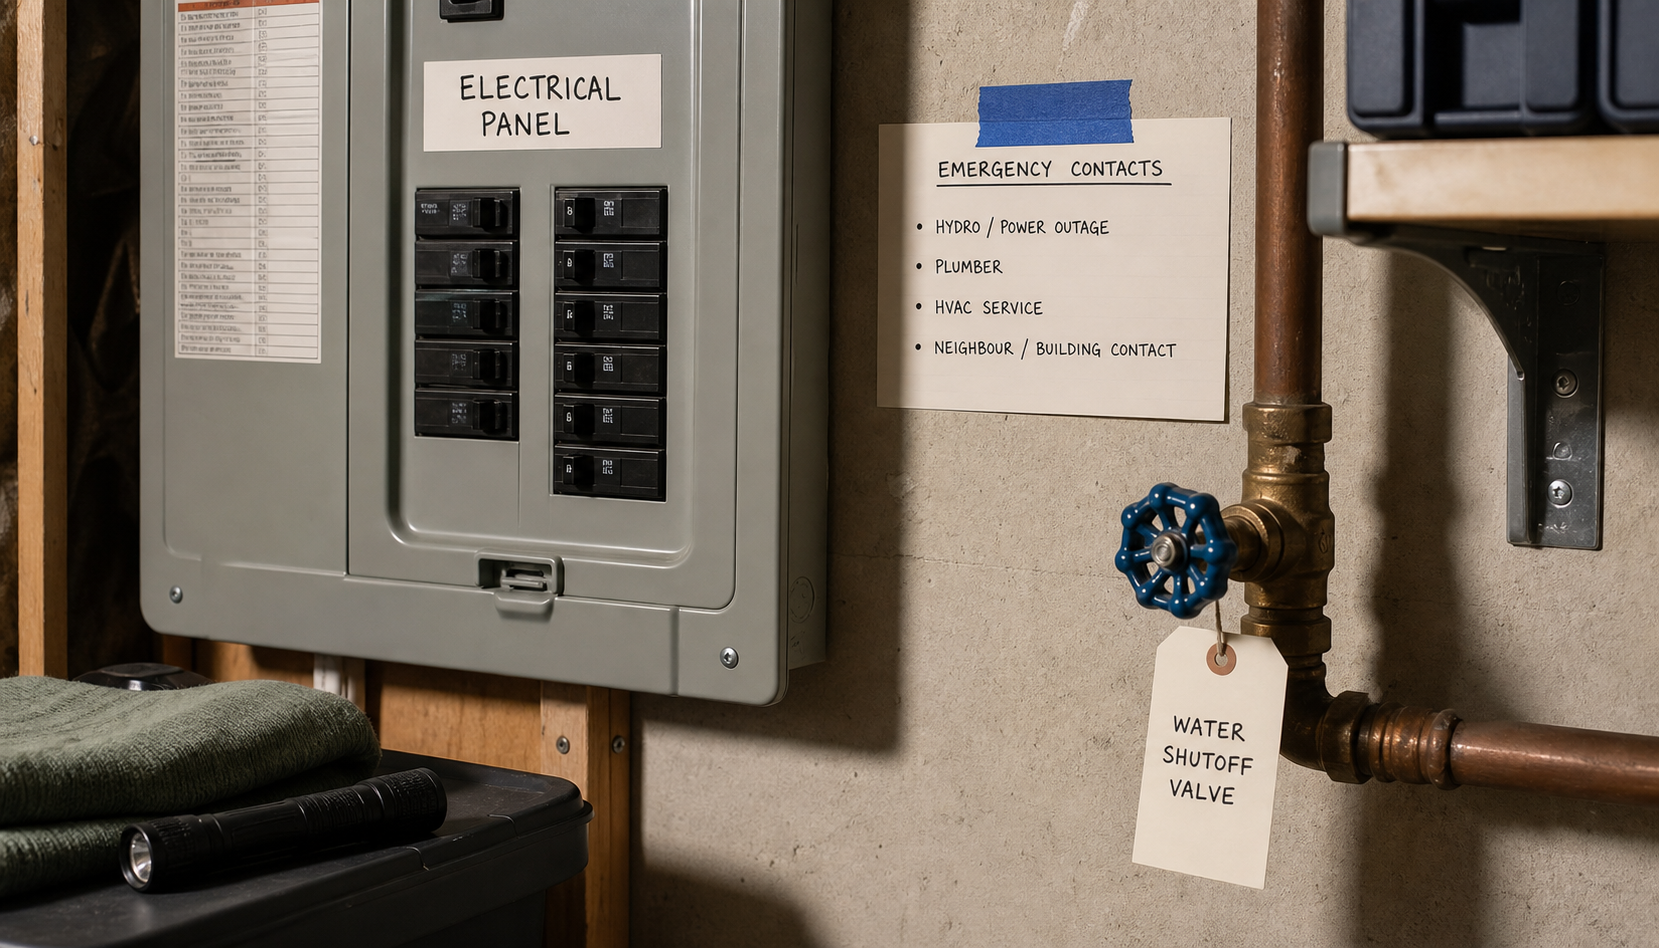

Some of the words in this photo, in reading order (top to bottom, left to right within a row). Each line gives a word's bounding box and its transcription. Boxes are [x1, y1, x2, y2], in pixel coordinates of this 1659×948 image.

[460, 74, 622, 102] ELECTRICAL
[481, 110, 570, 137] PANEL
[938, 160, 1052, 179] EMERGENCY
[1071, 159, 1163, 177] CONTACTS
[936, 219, 981, 234] HYDRO
[986, 216, 995, 239] /
[1000, 219, 1047, 235] POWER
[1054, 220, 1110, 236] OUTAGE
[935, 258, 1003, 274] PLUMBER
[935, 299, 972, 315] HVAC
[983, 300, 1043, 316] SERVICE
[934, 340, 1014, 356] NEIGHBOUR
[1020, 338, 1029, 360] /
[1036, 341, 1101, 358] BUILDING
[1110, 342, 1177, 358] CONTACT
[1173, 715, 1246, 742] WATER
[1162, 745, 1254, 776] SHUTOFF
[1169, 779, 1236, 805] VALVE
